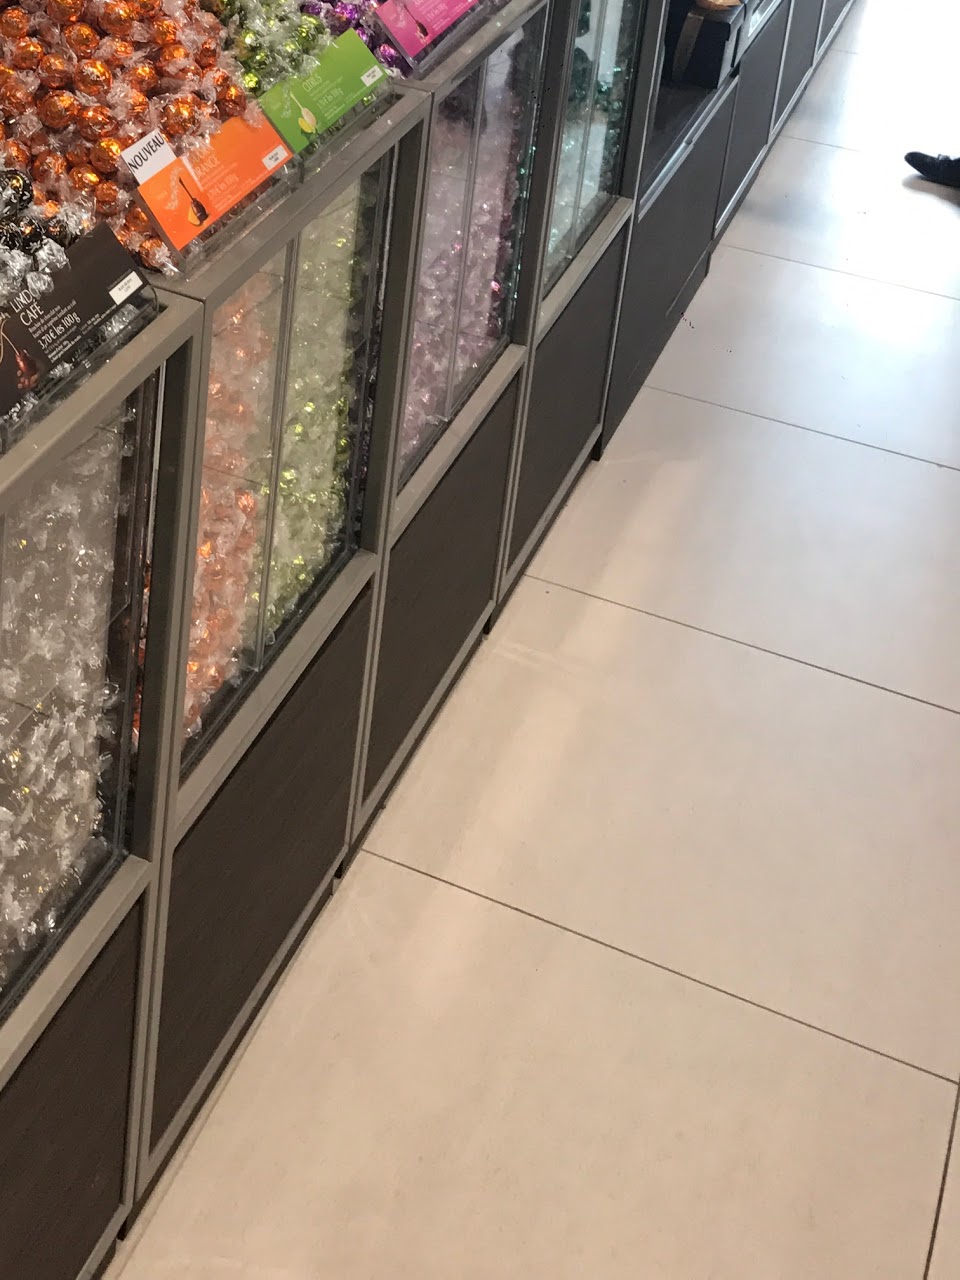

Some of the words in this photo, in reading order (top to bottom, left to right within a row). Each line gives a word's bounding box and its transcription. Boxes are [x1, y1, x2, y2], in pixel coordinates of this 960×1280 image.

[127, 132, 165, 173] NOUVEAU
[20, 299, 44, 326] CAFÉ
[55, 322, 66, 336] les
